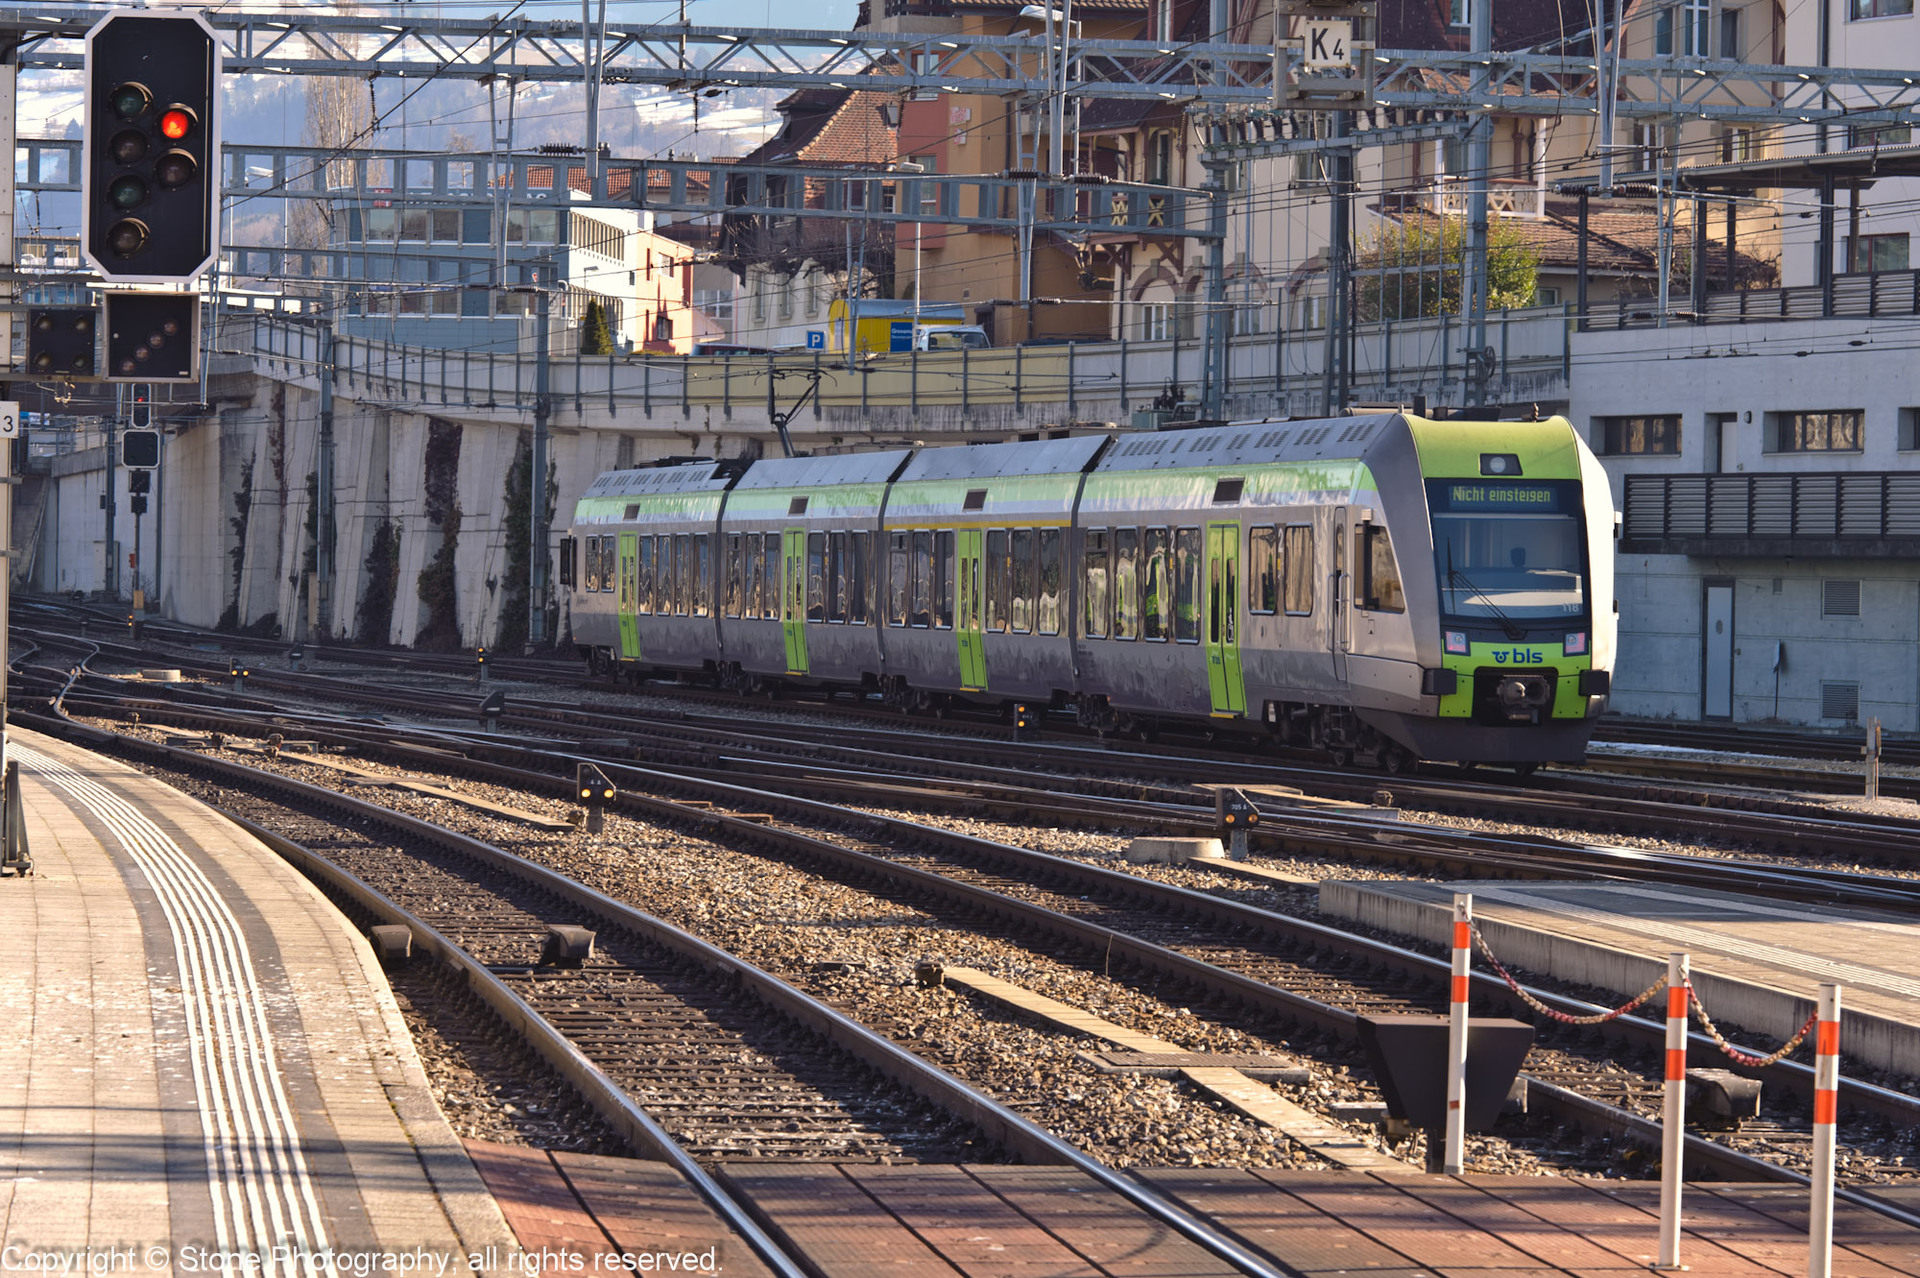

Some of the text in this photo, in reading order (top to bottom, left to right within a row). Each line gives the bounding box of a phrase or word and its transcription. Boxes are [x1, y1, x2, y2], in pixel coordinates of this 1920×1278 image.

[811, 334, 821, 347] P
[3, 415, 14, 432] 3
[1453, 486, 1551, 502] Nicht einsteigen
[1170, 530, 1175, 553] 2
[1278, 528, 1284, 553] 2
[1513, 648, 1543, 664] bls
